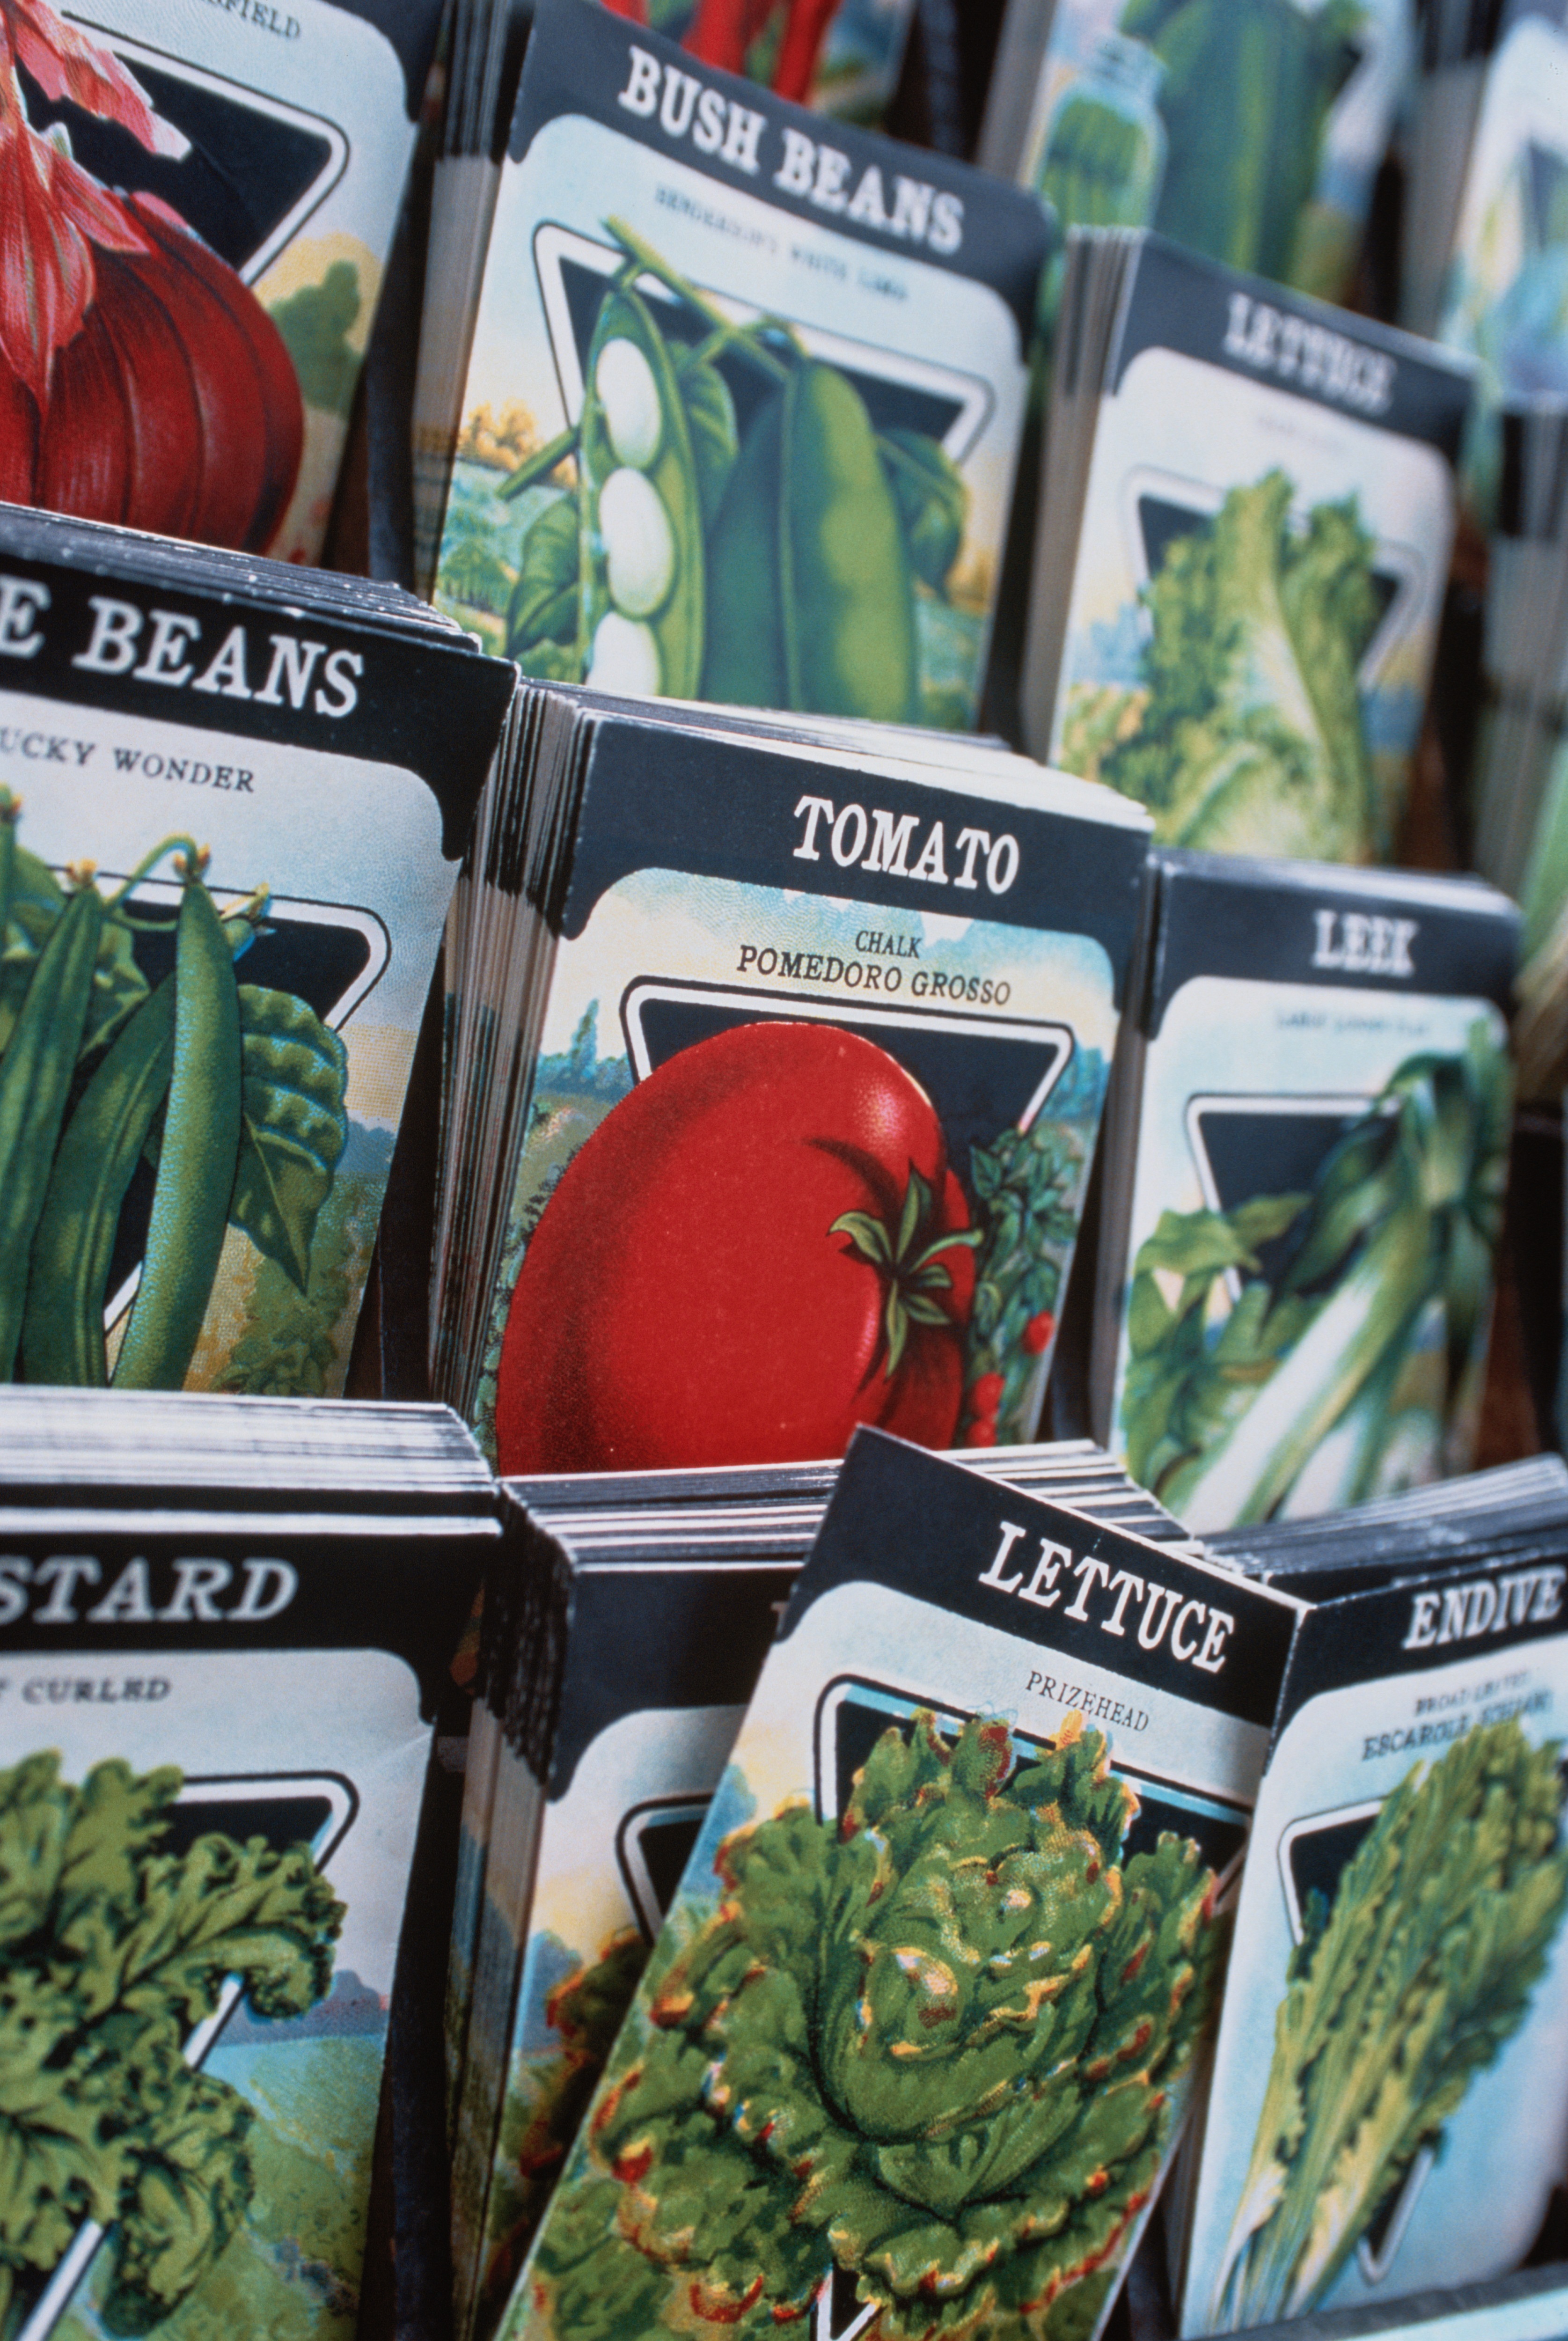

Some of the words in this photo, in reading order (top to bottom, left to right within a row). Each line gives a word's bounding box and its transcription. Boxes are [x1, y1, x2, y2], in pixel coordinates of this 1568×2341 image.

[618, 44, 768, 175] BUSH
[773, 126, 965, 255] BEANS
[1223, 292, 1397, 416] LETTUCE
[72, 594, 365, 719] BEANS
[113, 747, 256, 794] WONDER
[793, 795, 1020, 895] TOMATO
[736, 944, 902, 992] POMEDORO
[911, 970, 1011, 1006] GROSSO
[855, 930, 922, 959] CHALK
[1311, 908, 1421, 979] LEEK
[978, 1520, 1234, 1673] LETTUCE
[1401, 1563, 1567, 1650] ENDIVE
[21, 1675, 173, 1705] CURLED
[1025, 1670, 1149, 1732] PRIZEHEAD
